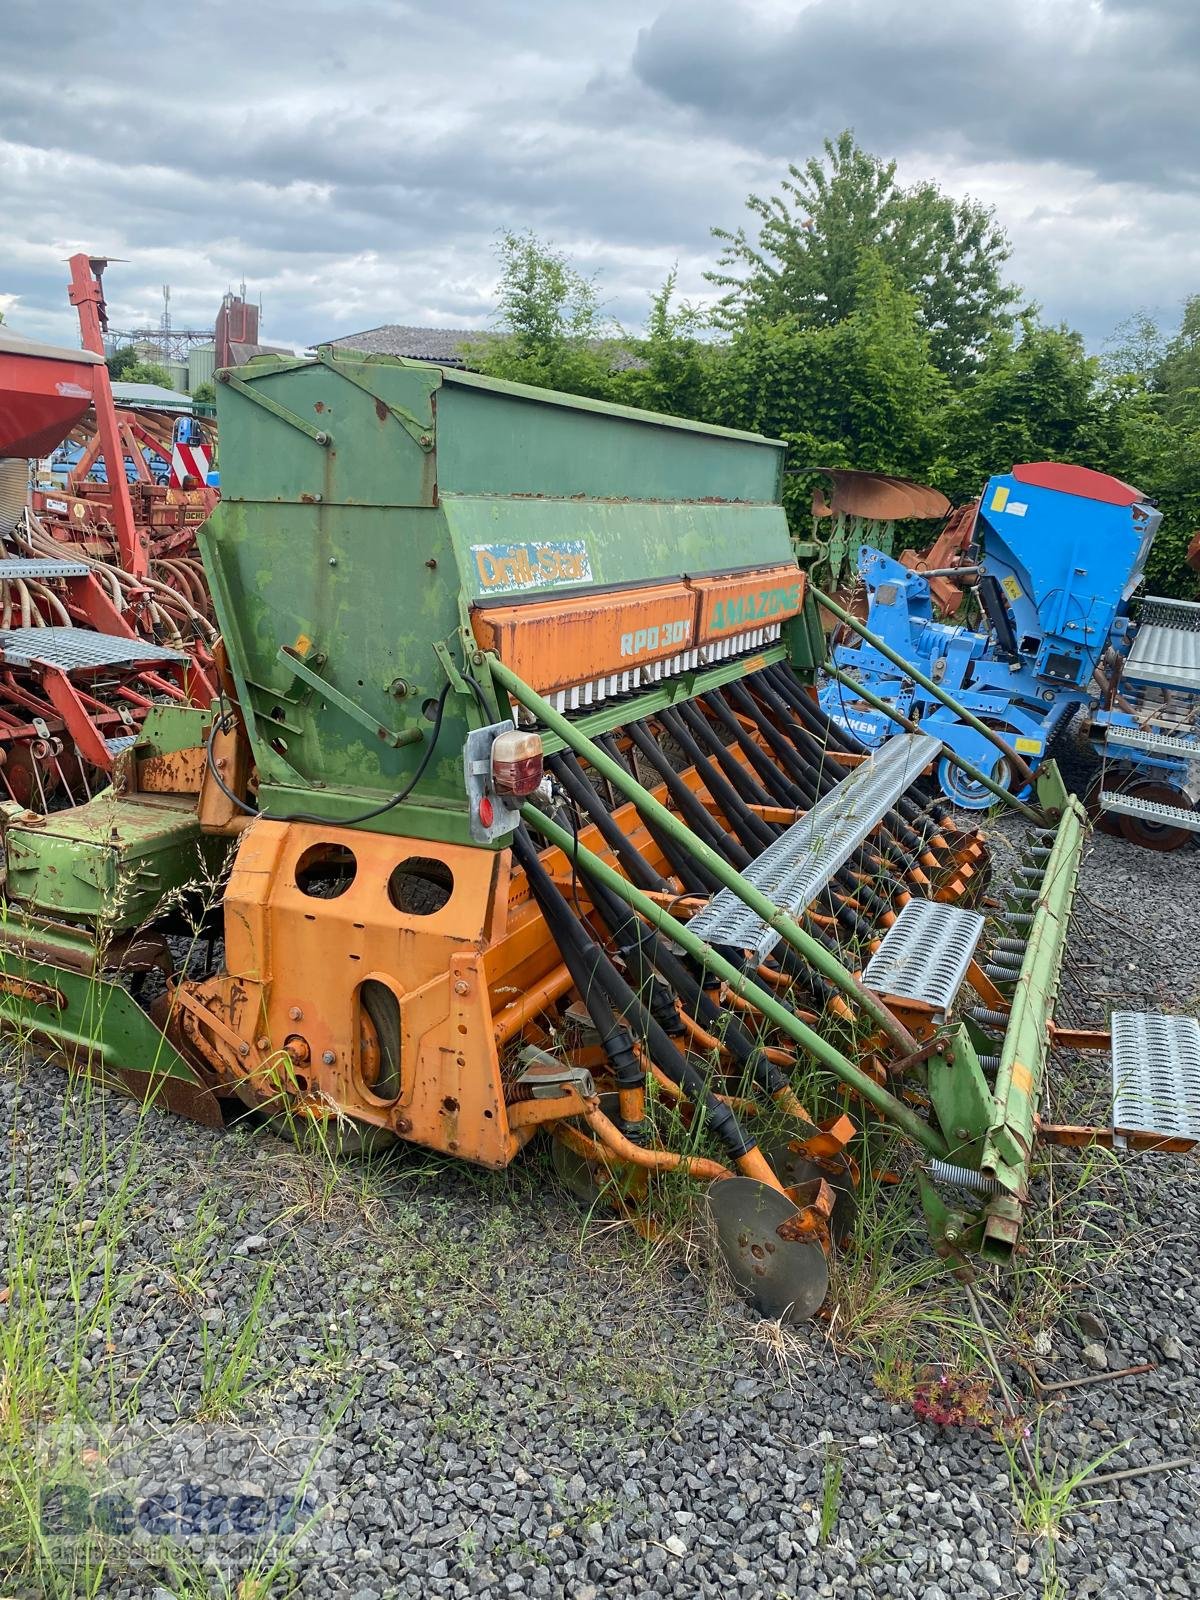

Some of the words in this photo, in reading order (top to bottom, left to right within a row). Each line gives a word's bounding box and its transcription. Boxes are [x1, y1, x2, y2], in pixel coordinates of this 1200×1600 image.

[175, 512, 205, 520] OCHE
[710, 584, 801, 631] AMAZONE
[620, 626, 659, 657] RPD
[827, 713, 877, 735] EMKEN
